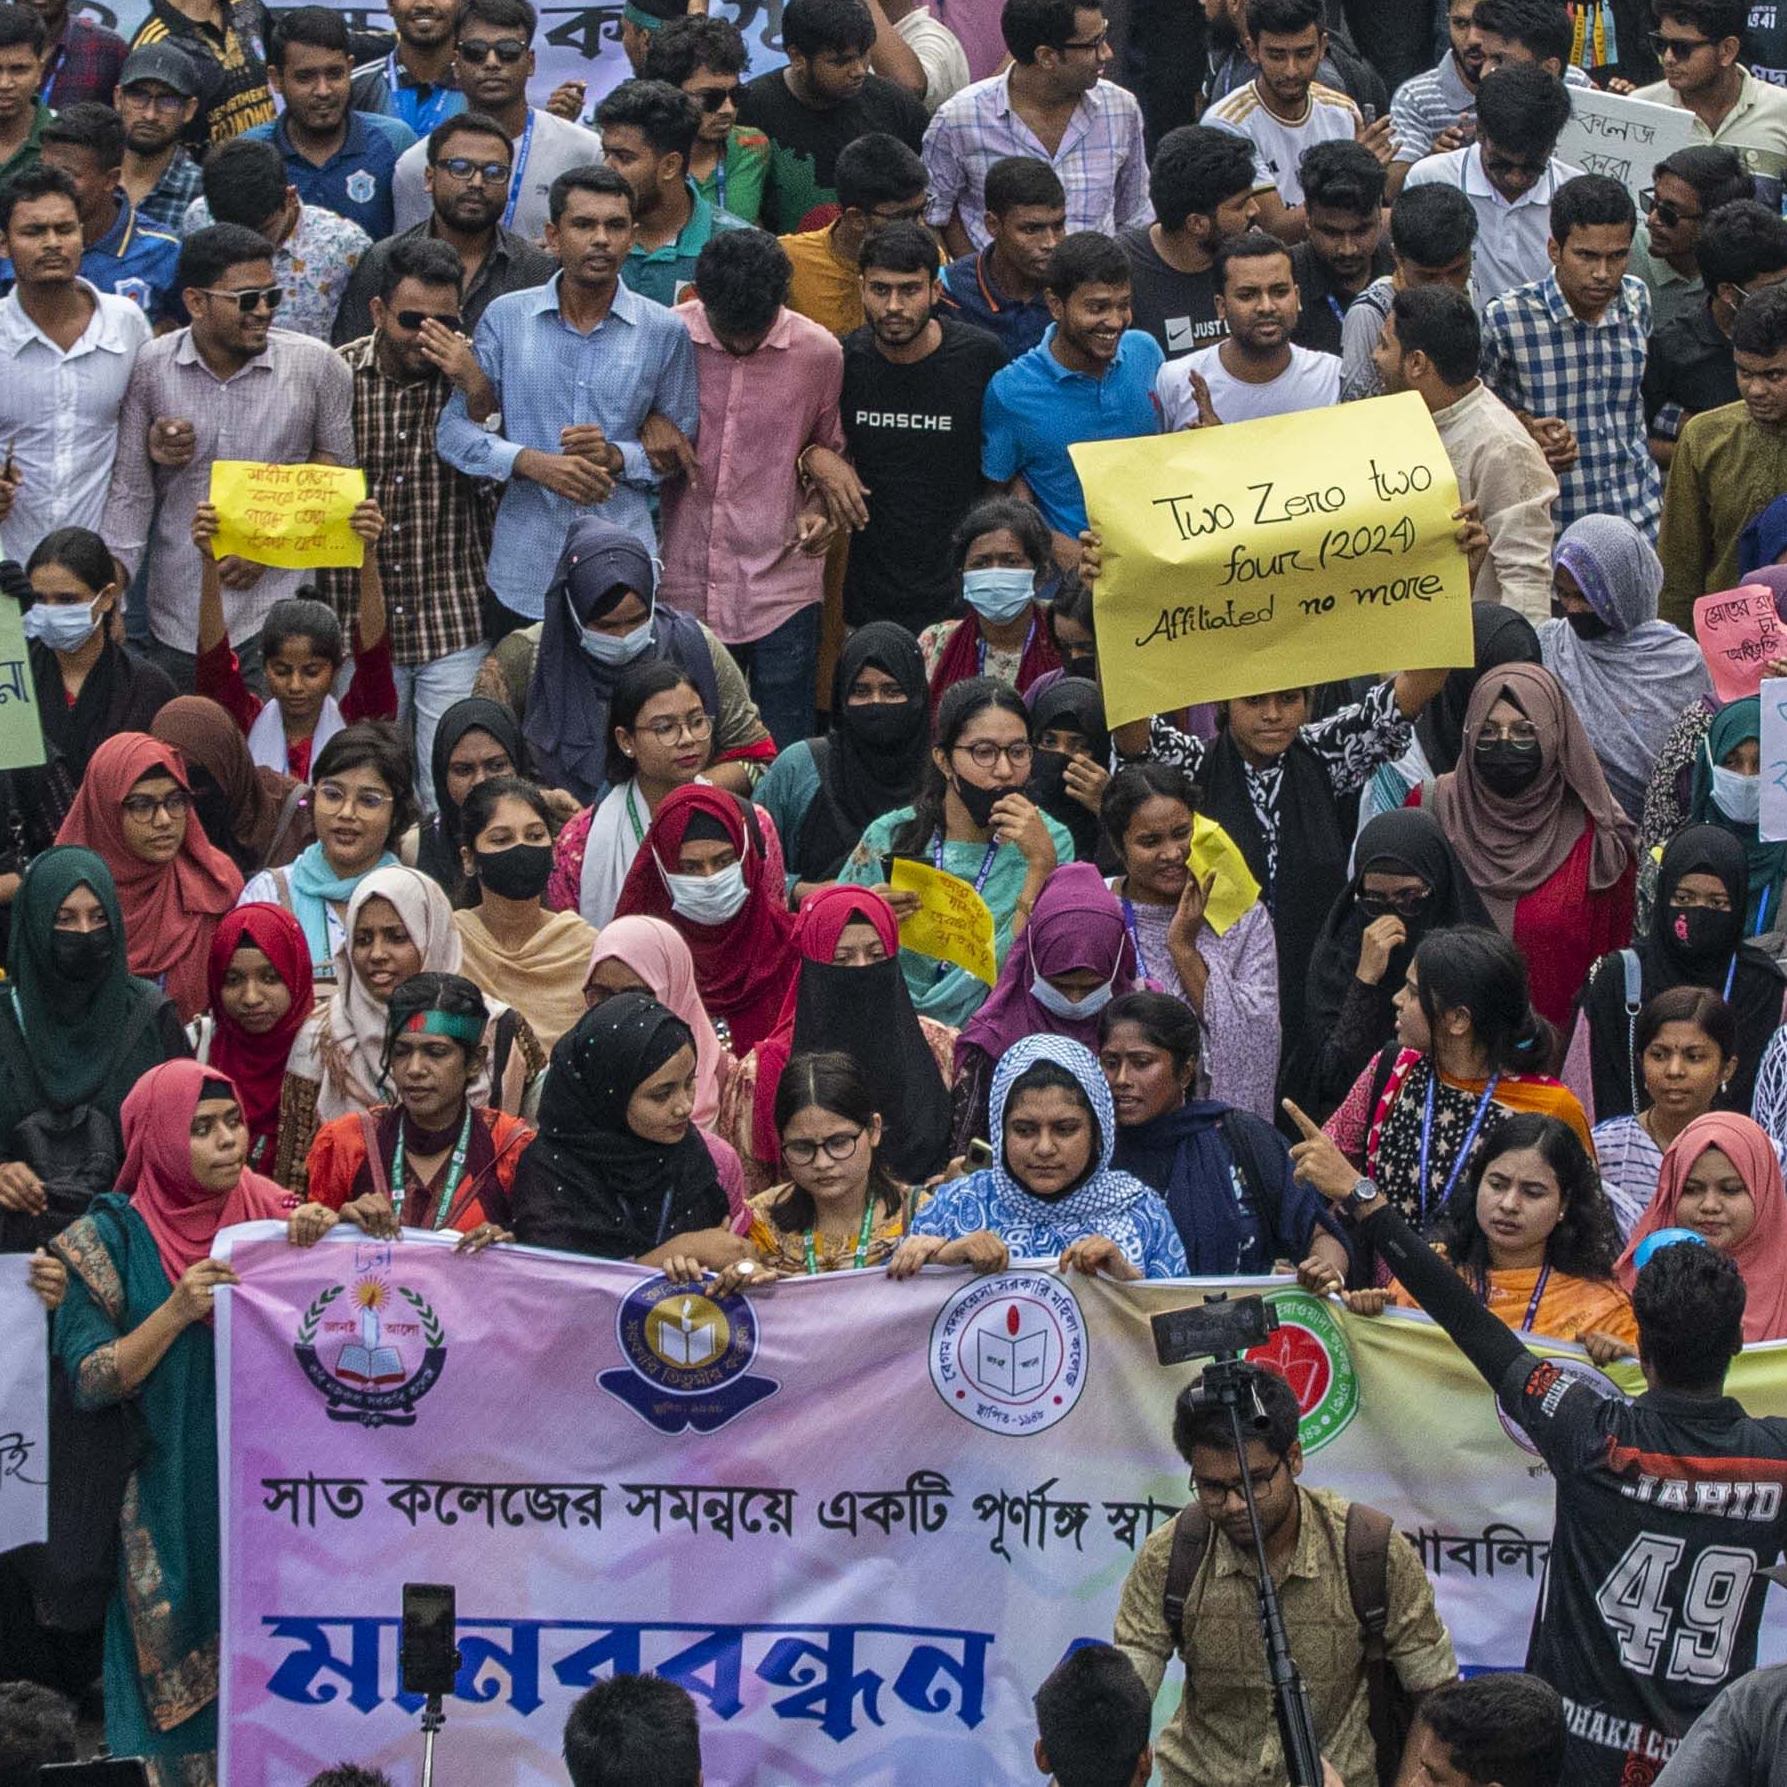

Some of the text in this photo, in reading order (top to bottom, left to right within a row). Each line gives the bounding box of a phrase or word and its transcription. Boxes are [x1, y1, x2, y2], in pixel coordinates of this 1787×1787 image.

[856, 410, 953, 431] PORSCHE
[1151, 458, 1433, 543] Two Zero two
[1218, 541, 1314, 587] four
[1134, 566, 1445, 648] Affiliated no more
[262, 1470, 367, 1530] সাত
[384, 1475, 607, 1530] কলেজের
[618, 1482, 798, 1542] সমন্বয়ে
[816, 1469, 956, 1534] একটি
[971, 1475, 1092, 1564] পূর্ণাঙ্গ
[1596, 1530, 1760, 1686] 49
